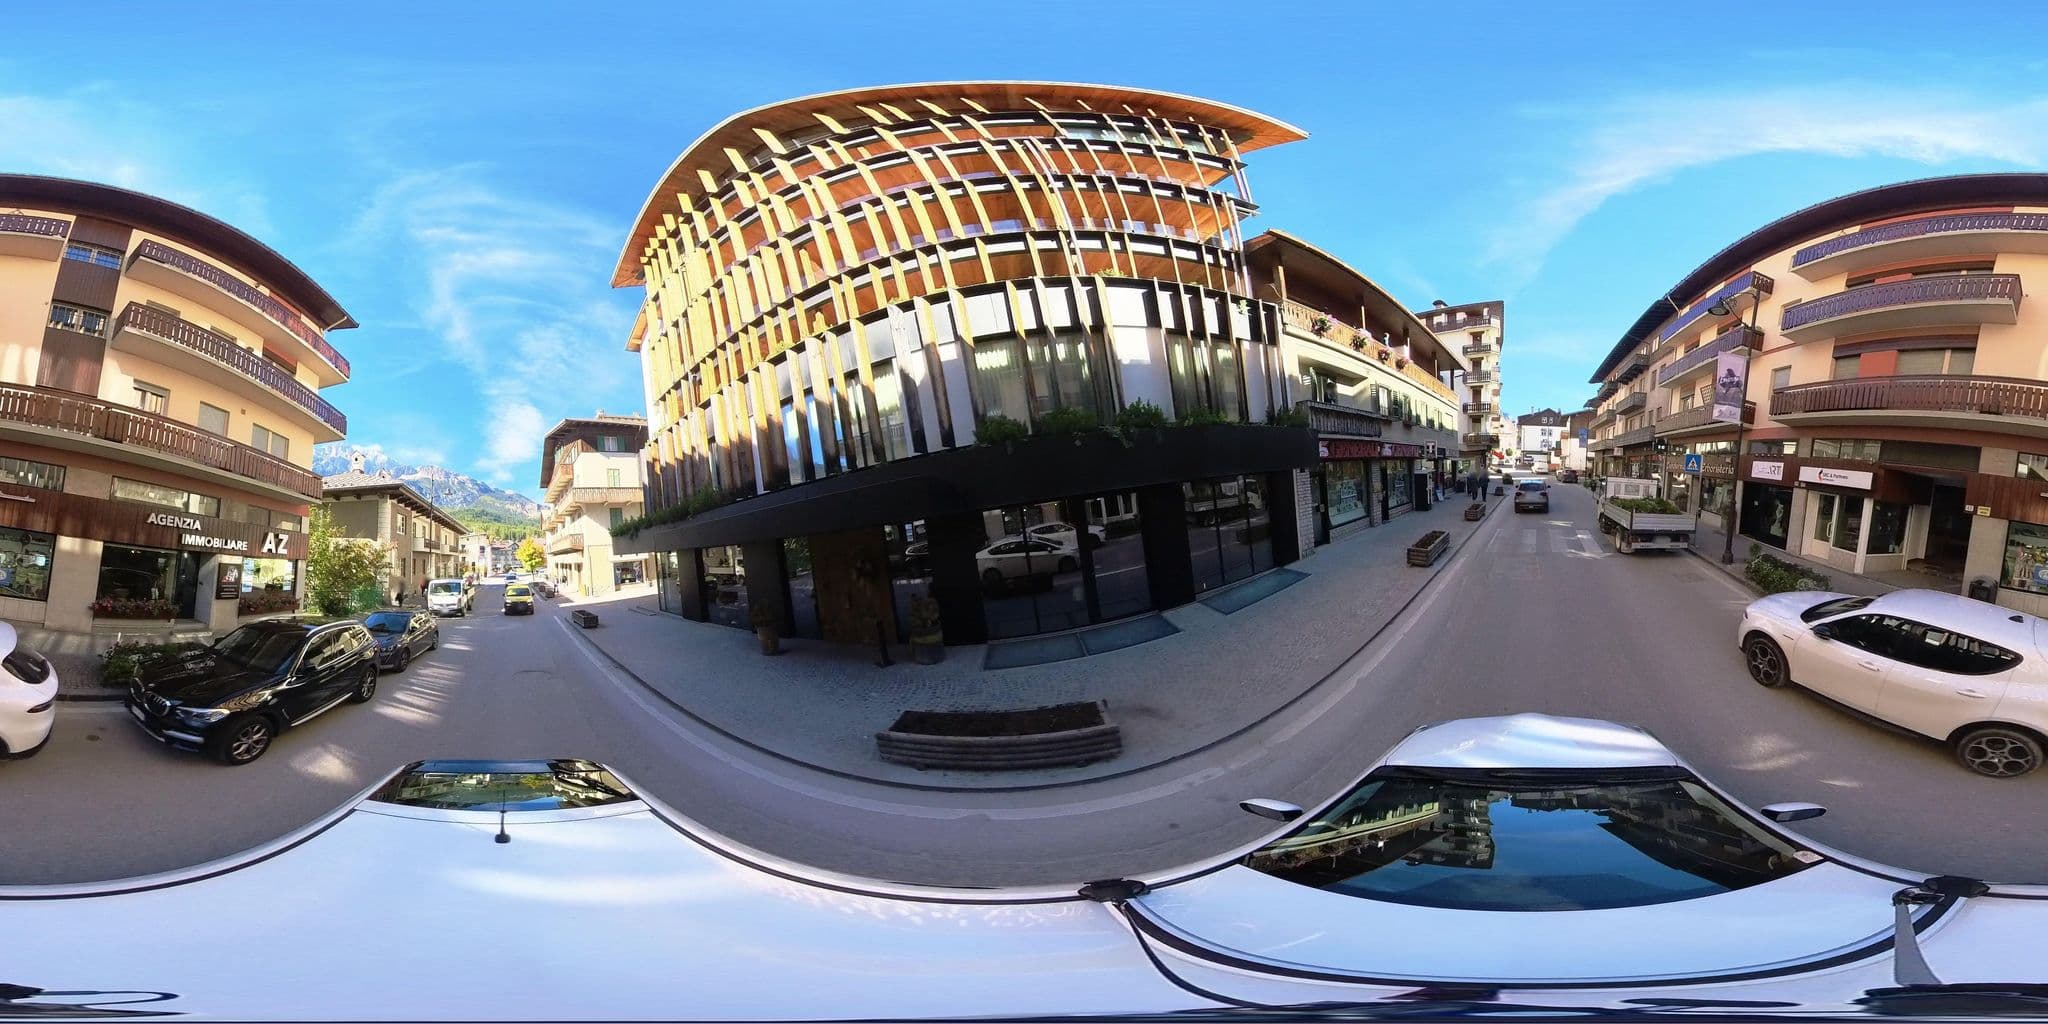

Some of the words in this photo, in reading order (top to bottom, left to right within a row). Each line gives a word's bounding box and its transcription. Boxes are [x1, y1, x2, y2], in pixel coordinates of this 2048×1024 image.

[147, 512, 201, 530] AGENZIA
[181, 534, 248, 550] IMMOBILIARE
[261, 532, 289, 555] AZ
